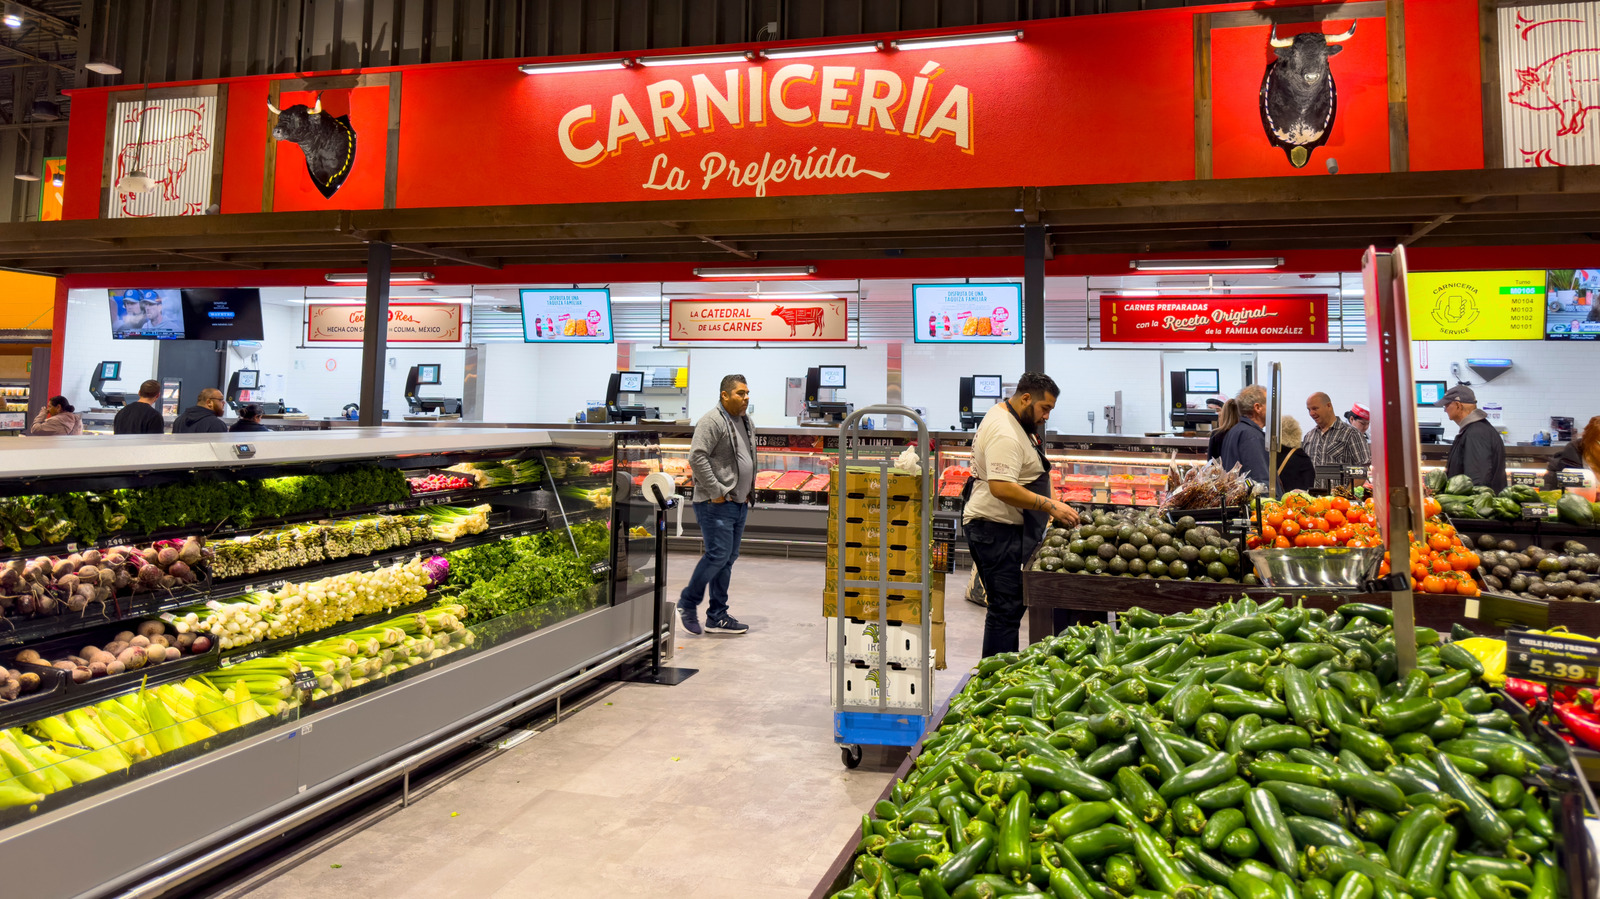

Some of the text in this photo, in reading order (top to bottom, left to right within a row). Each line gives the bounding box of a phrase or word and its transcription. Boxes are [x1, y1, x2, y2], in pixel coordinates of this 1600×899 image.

[558, 60, 974, 167] CARNICERÍA
[642, 153, 690, 190] La
[1157, 303, 1208, 311] PREPARADAS
[394, 310, 421, 324] Res
[701, 308, 751, 318] CATEDRAL
[1162, 315, 1210, 331] Receta
[1211, 305, 1278, 326] Original
[418, 325, 441, 333] MÉXICO
[723, 322, 763, 332] CARNES
[1225, 327, 1258, 335] FAMILIA
[1260, 326, 1303, 335] GONZÁLEZ
[1440, 327, 1470, 335] SERVICE
[1543, 641, 1564, 650] ROJO
[1529, 659, 1585, 680] 5.39
